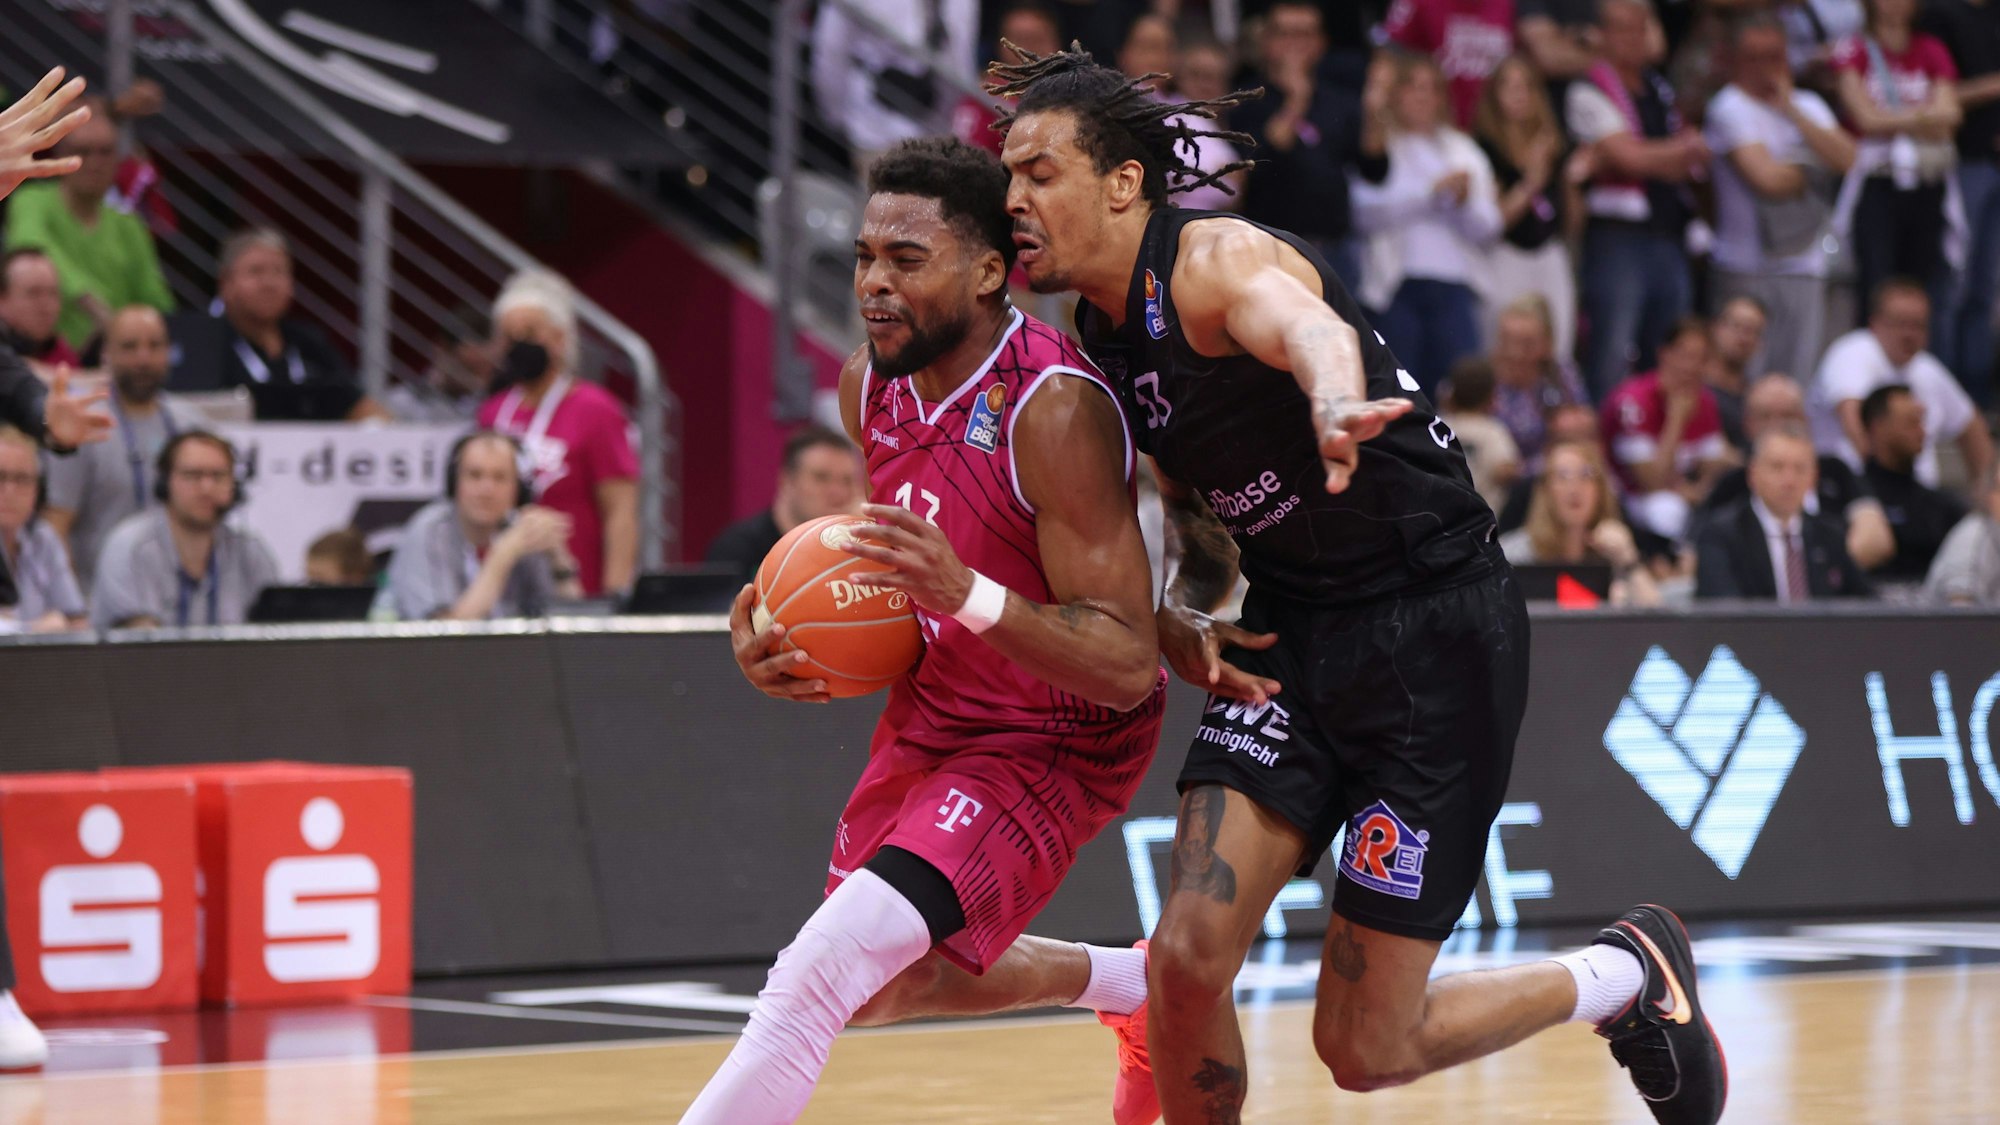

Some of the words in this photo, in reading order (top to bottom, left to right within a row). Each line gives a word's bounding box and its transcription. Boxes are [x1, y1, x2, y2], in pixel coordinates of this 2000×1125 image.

[1134, 371, 1172, 429] 53
[970, 426, 995, 447] BBL
[1195, 725, 1280, 768] rmöglicht
[1864, 670, 2000, 827] H
